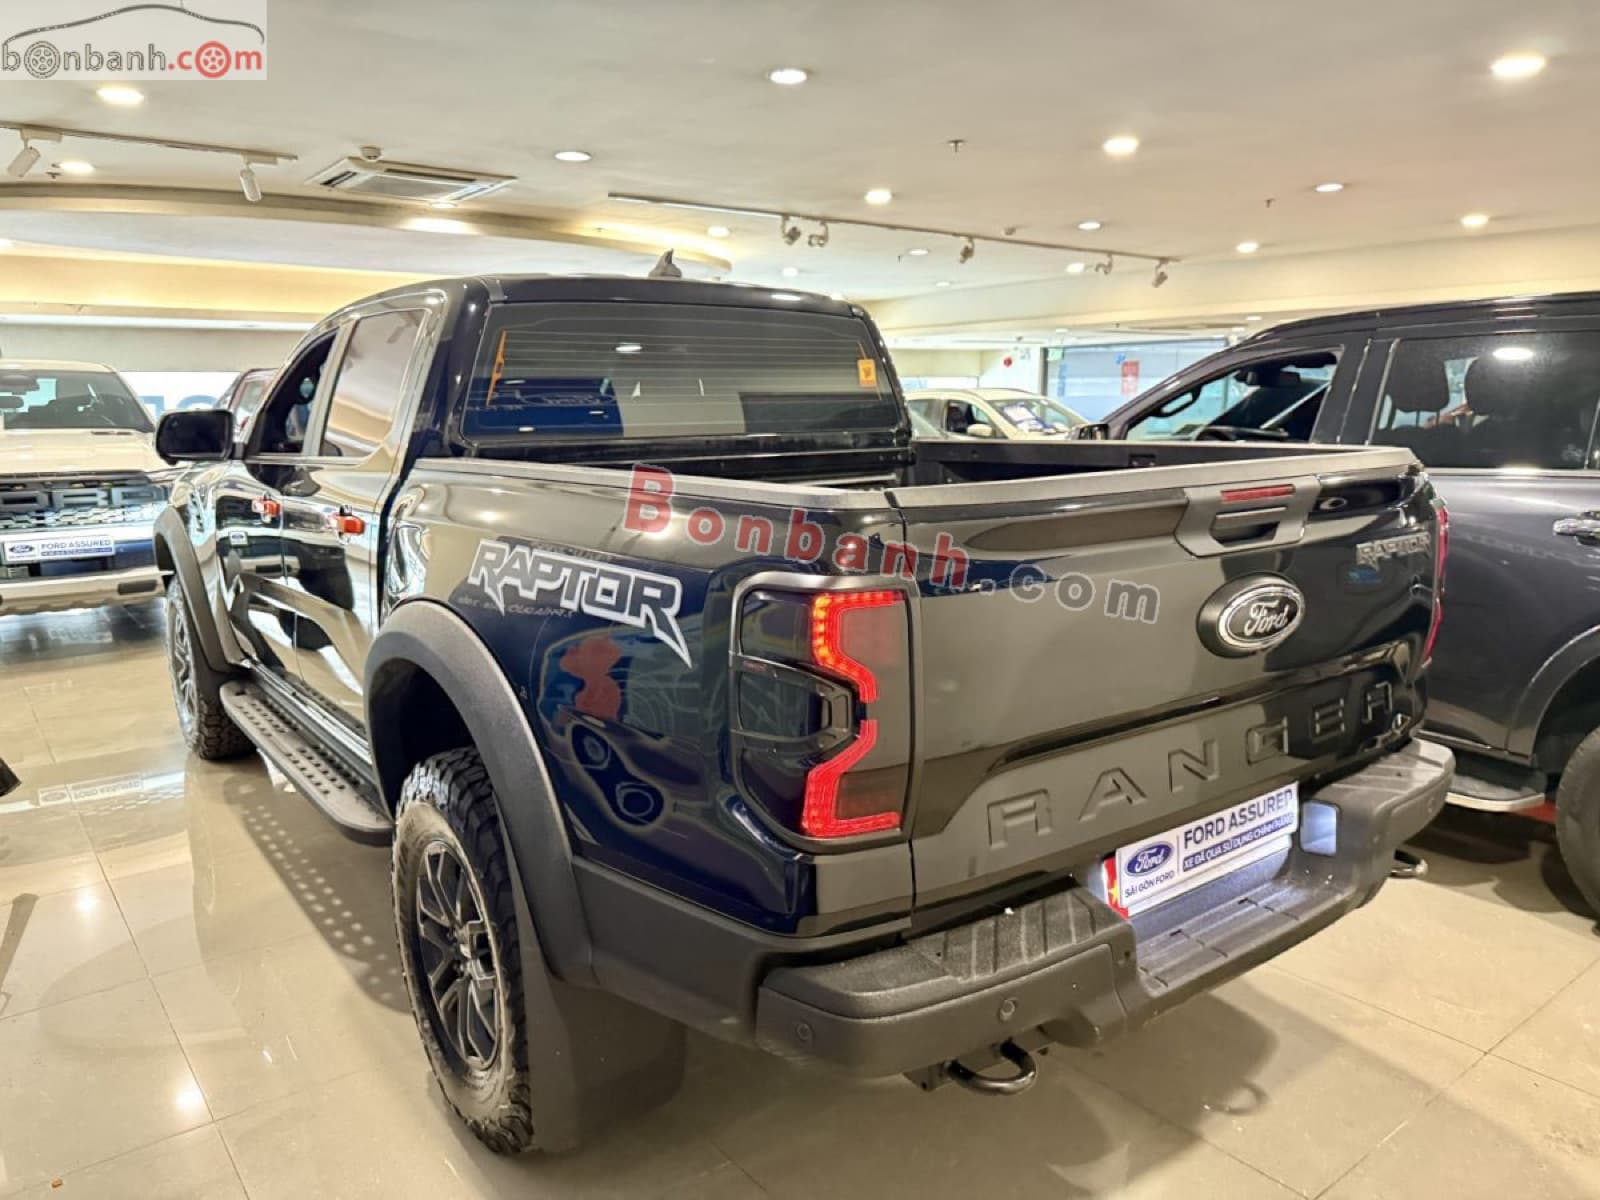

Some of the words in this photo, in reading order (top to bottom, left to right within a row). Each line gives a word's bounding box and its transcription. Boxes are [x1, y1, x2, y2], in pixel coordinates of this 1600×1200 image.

[69, 539, 111, 549] ASSURED
[1356, 531, 1432, 573] RAPTOR
[468, 539, 692, 669] RAPTOR
[1243, 599, 1289, 637] Ford
[986, 682, 1395, 849] RANGER
[1184, 817, 1225, 849] FORD
[1229, 789, 1293, 831] ASSURED
[1135, 847, 1165, 872] Ford
[1155, 869, 1175, 885] FORD
